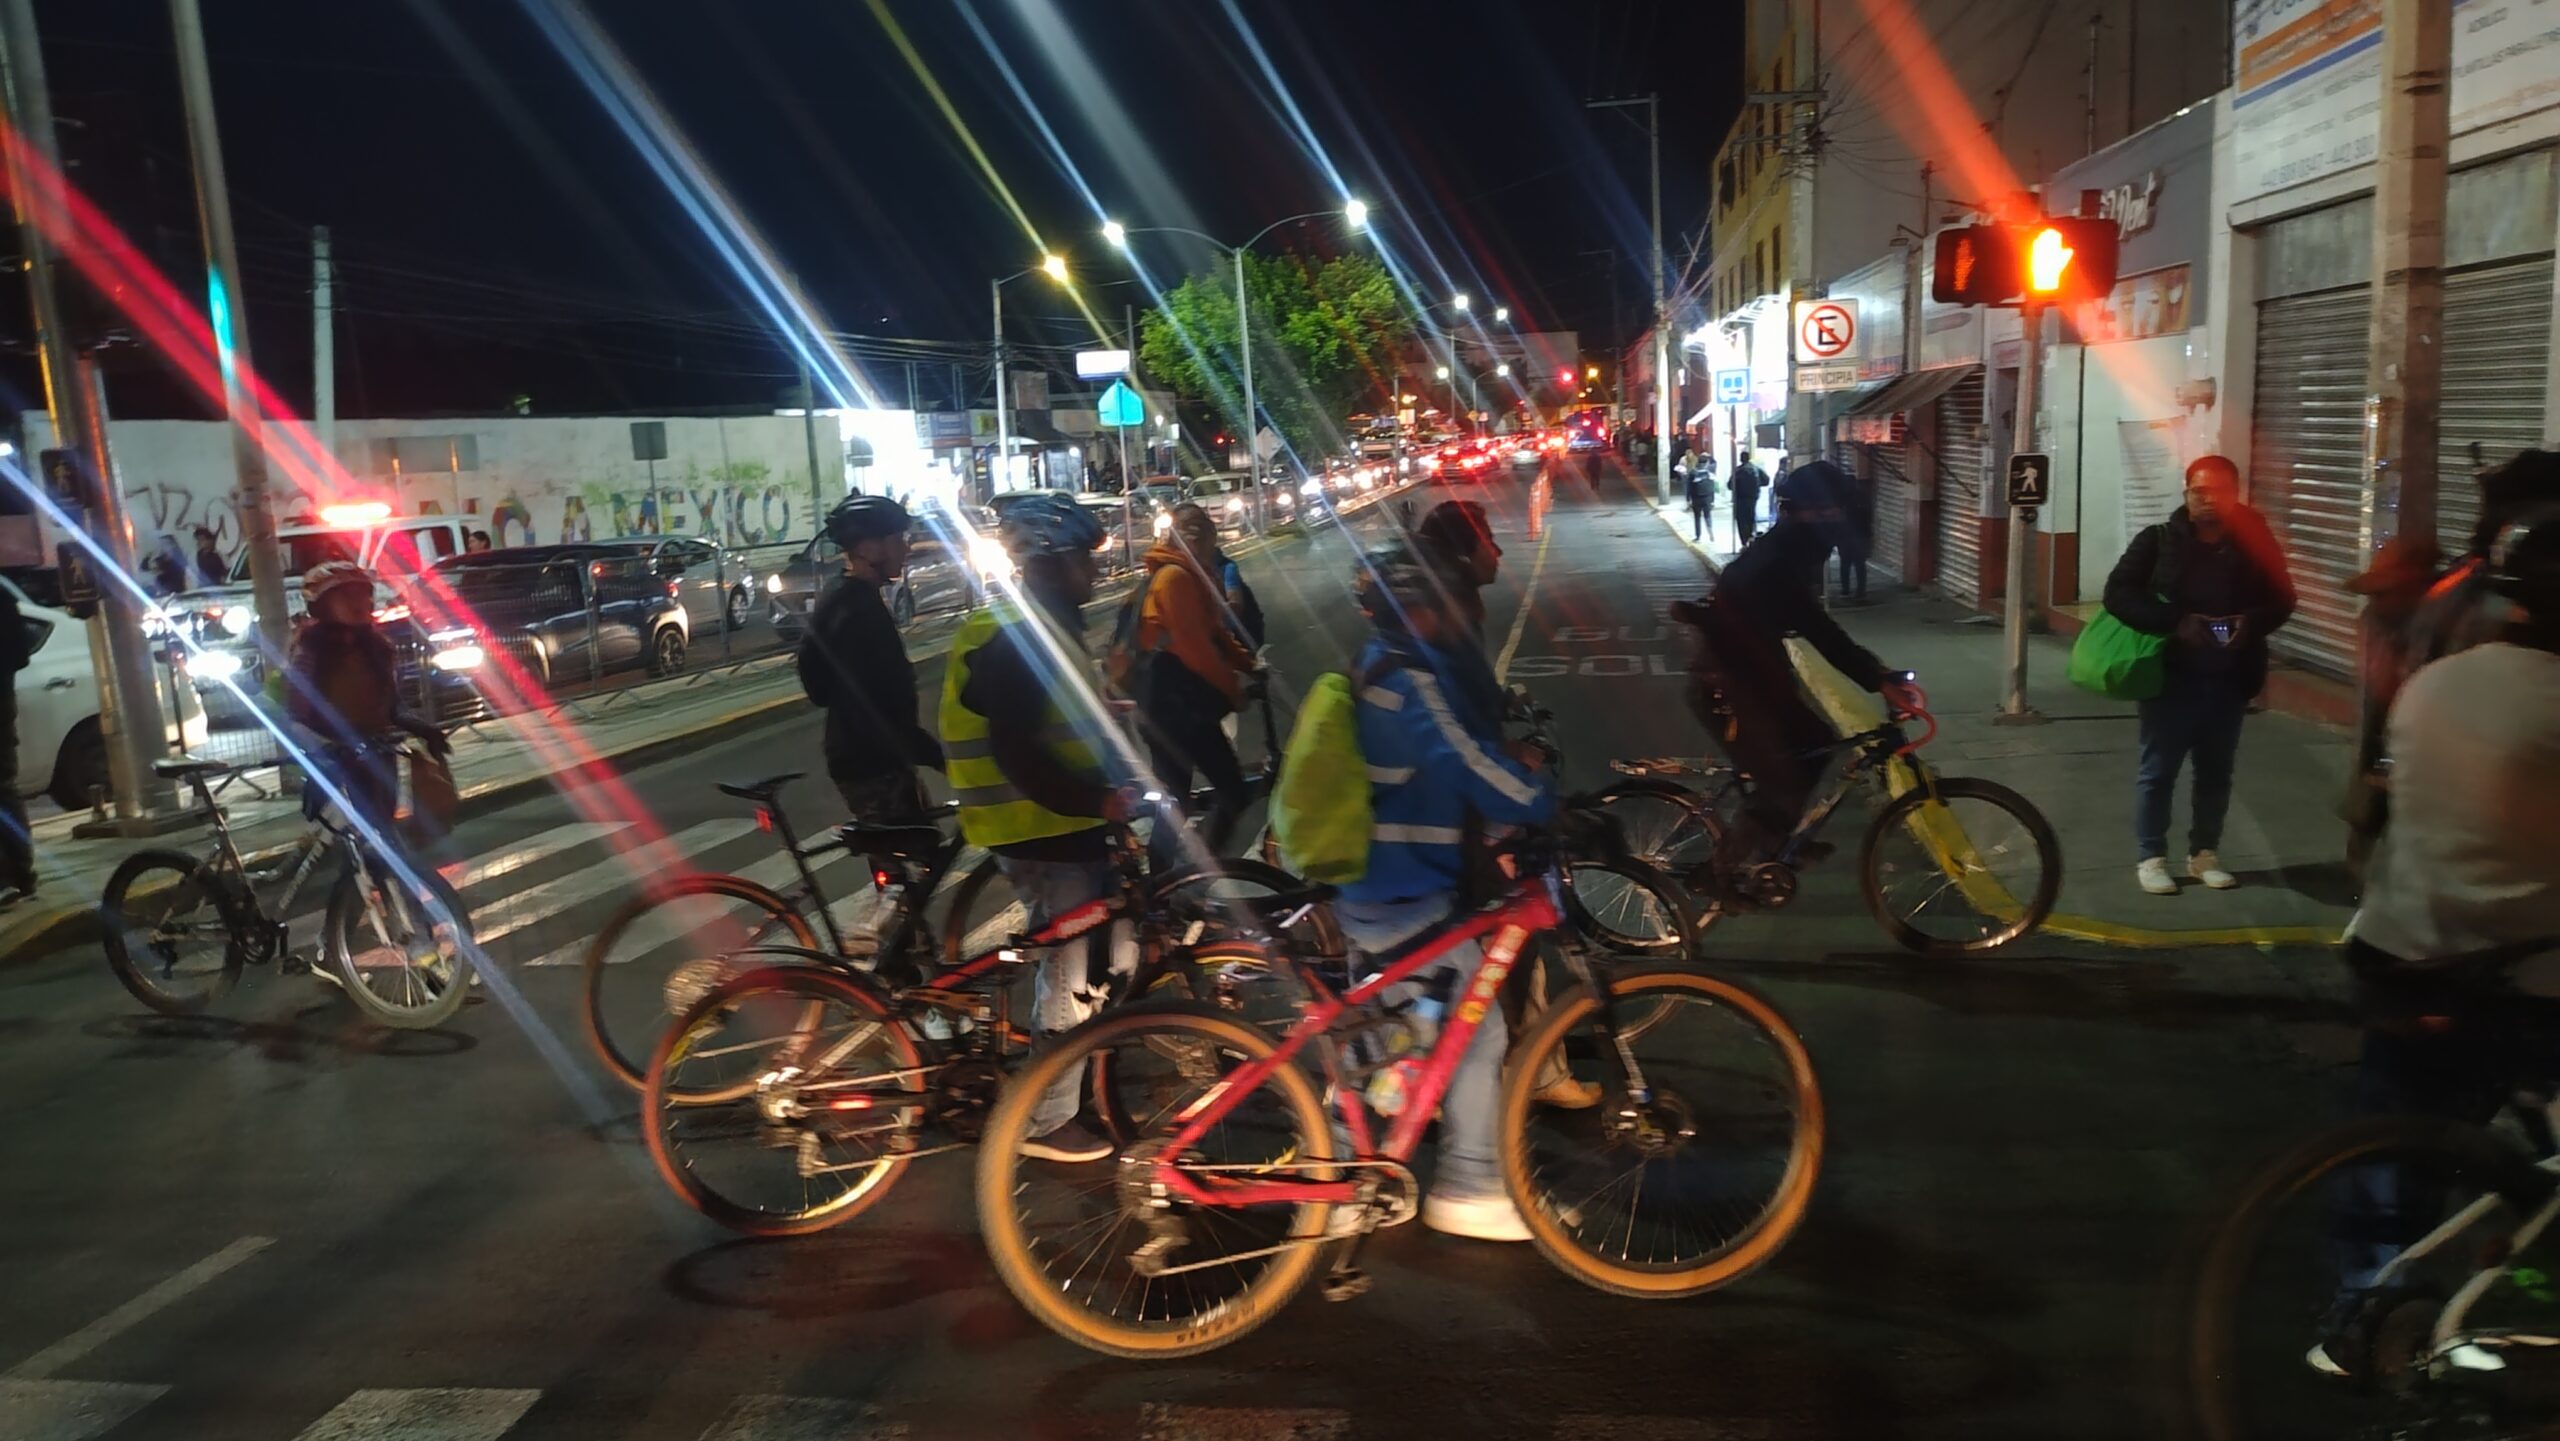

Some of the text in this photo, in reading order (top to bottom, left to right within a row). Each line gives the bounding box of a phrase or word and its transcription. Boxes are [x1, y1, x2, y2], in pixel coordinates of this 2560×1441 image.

[1818, 315, 1842, 345] E
[1799, 371, 1854, 387] PRINCIPIA
[1506, 654, 1688, 677] SOL
